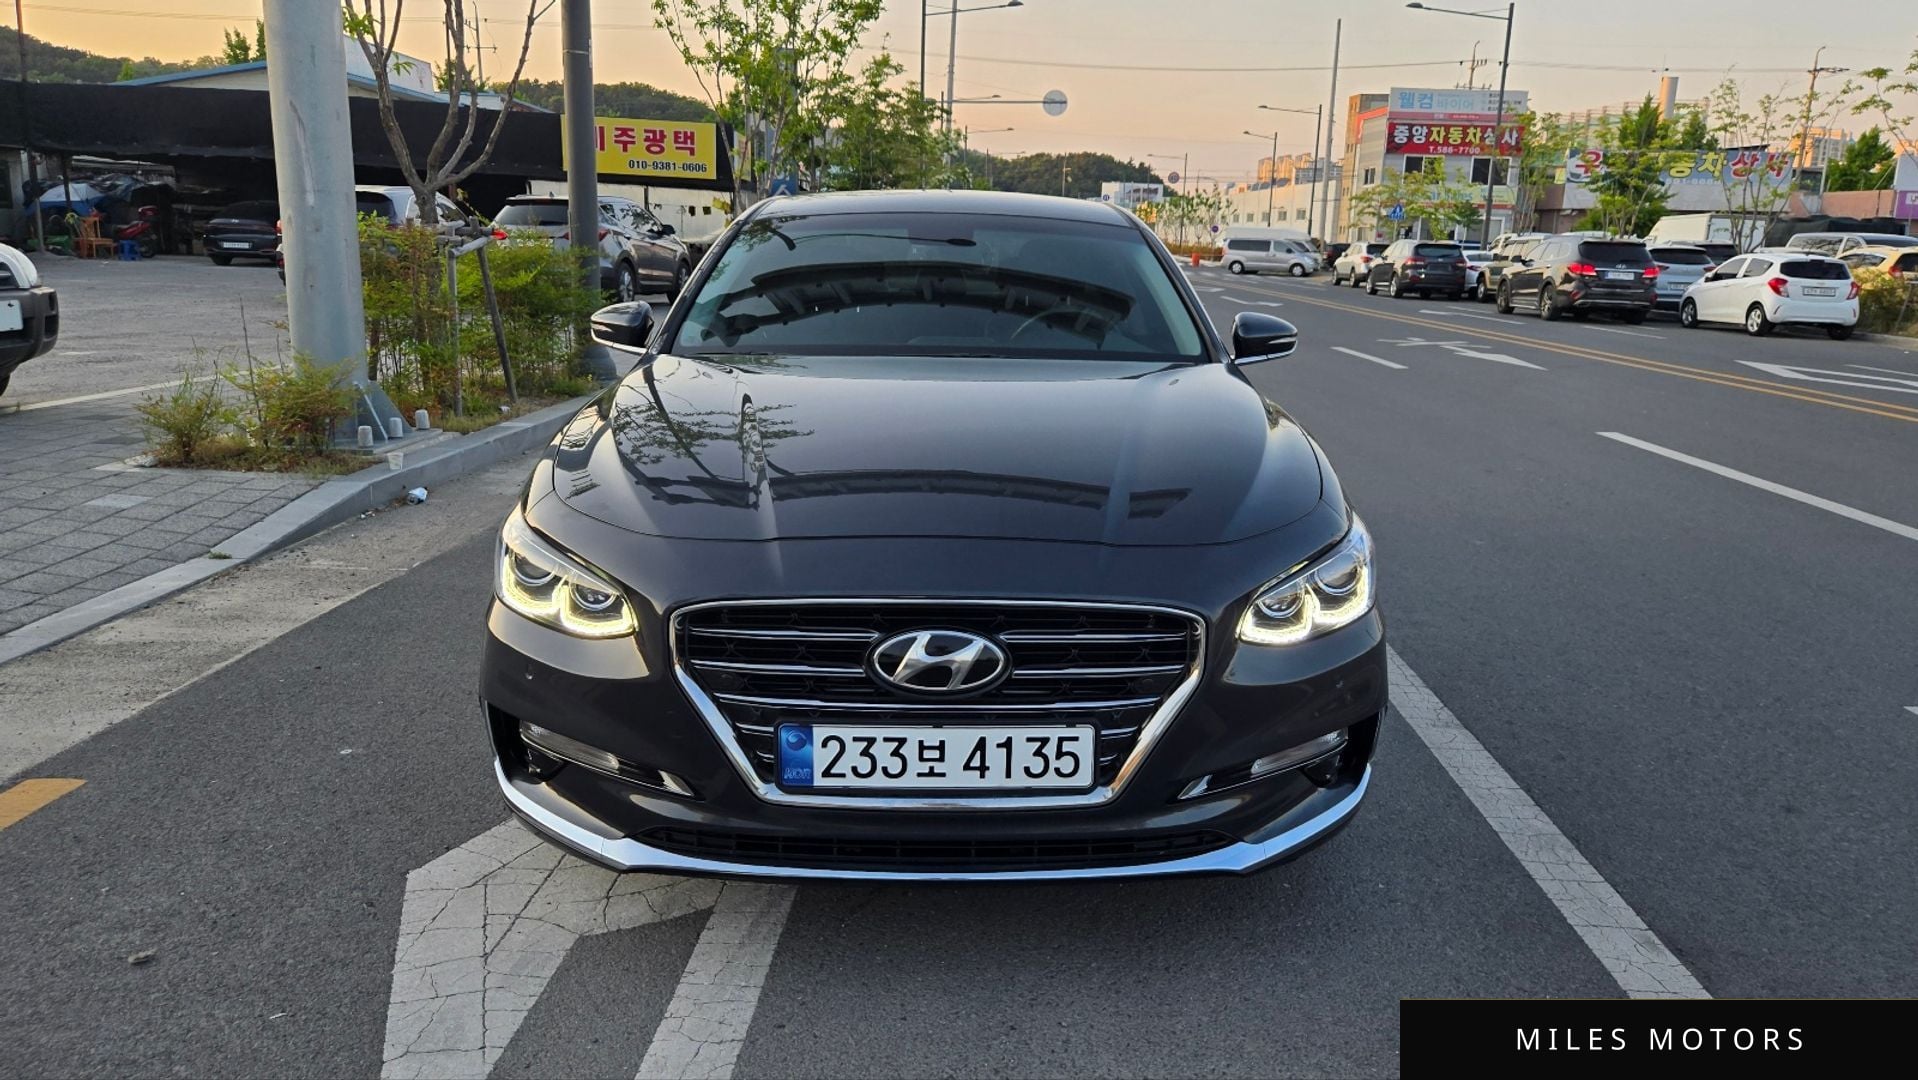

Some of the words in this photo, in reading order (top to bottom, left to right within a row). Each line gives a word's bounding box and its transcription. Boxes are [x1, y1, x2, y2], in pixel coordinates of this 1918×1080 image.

[1398, 91, 1434, 110] 웰컴
[628, 159, 708, 173] 010-9381-0606
[821, 735, 946, 779] 233보
[962, 736, 1080, 779] 4135
